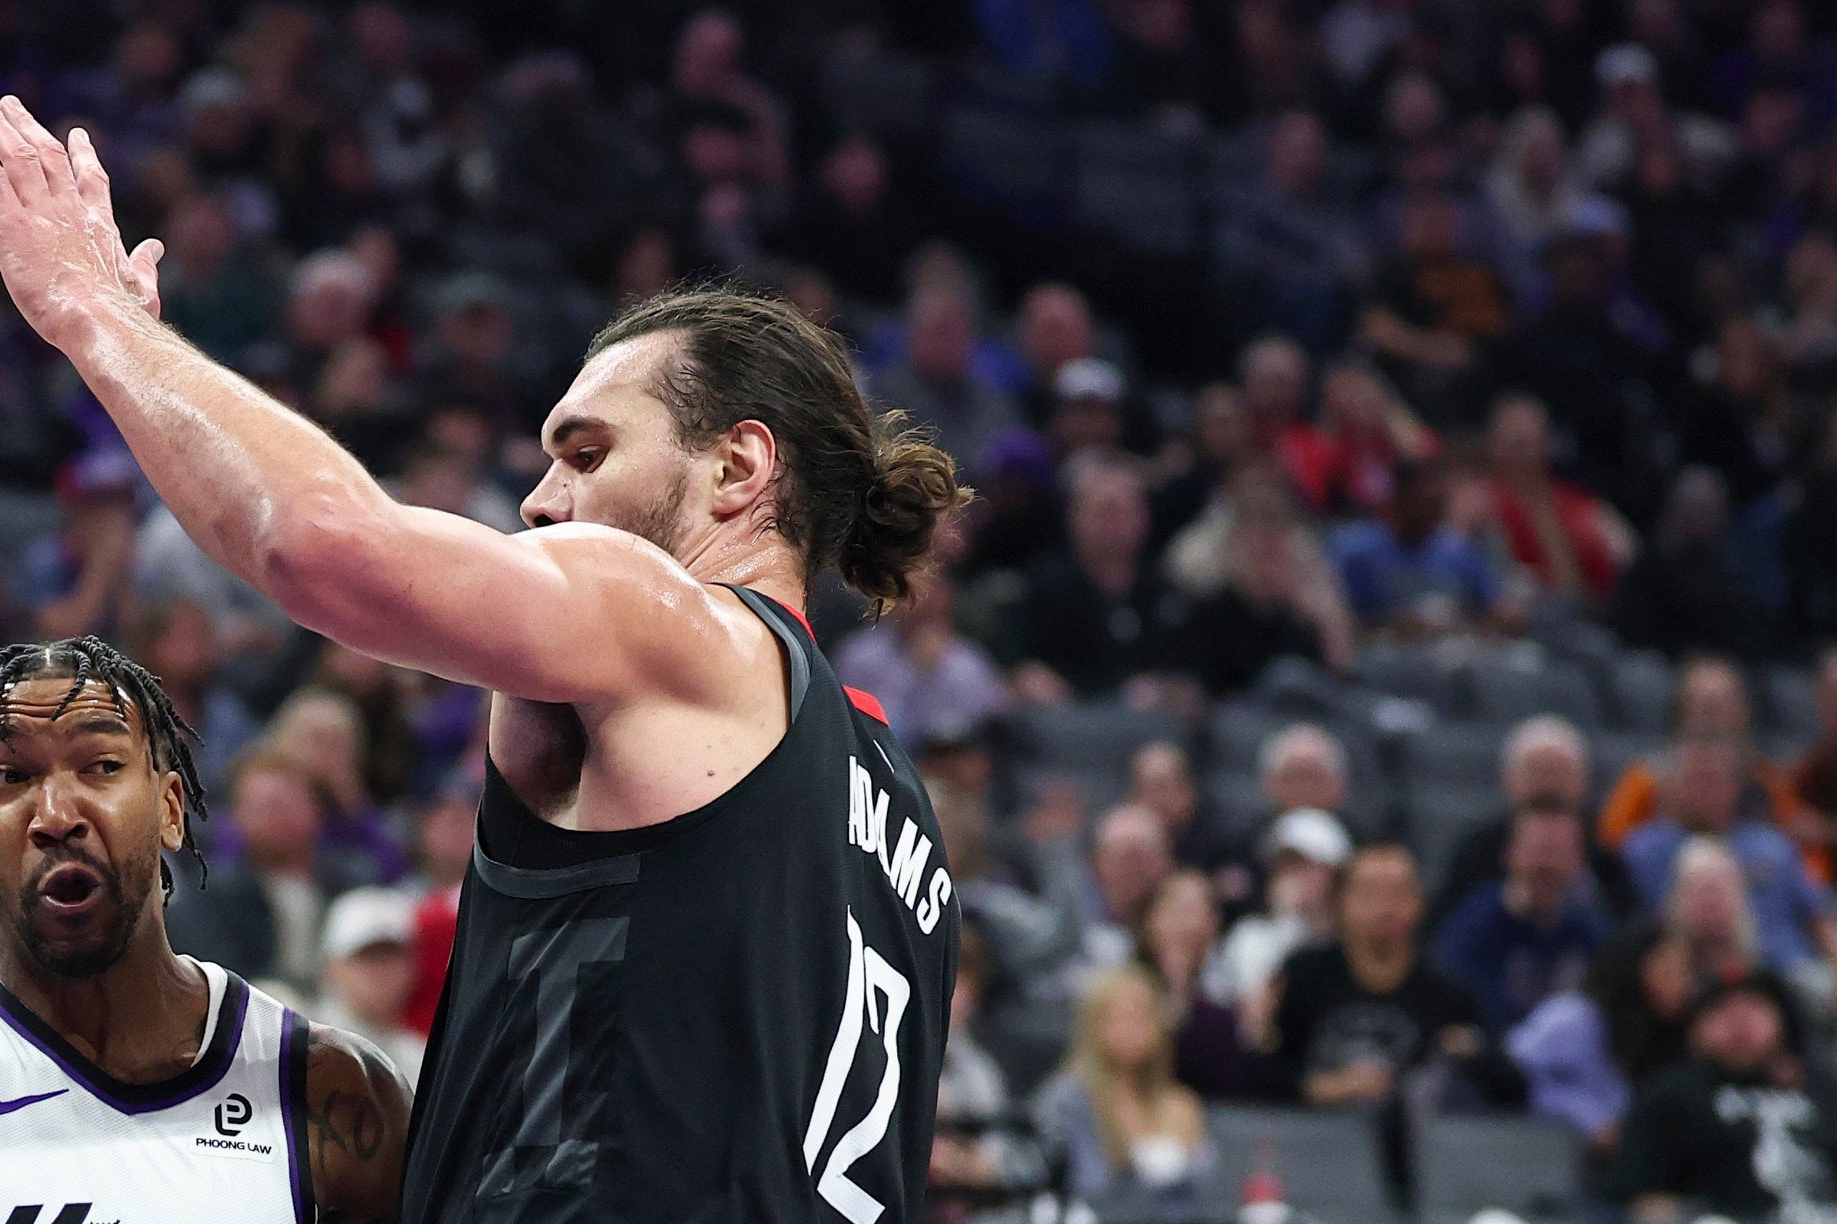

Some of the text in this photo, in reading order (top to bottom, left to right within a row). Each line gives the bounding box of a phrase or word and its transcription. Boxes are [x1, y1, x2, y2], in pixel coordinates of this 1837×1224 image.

[848, 755, 952, 935] ADAMS
[195, 1137, 272, 1155] PHOONG LAW
